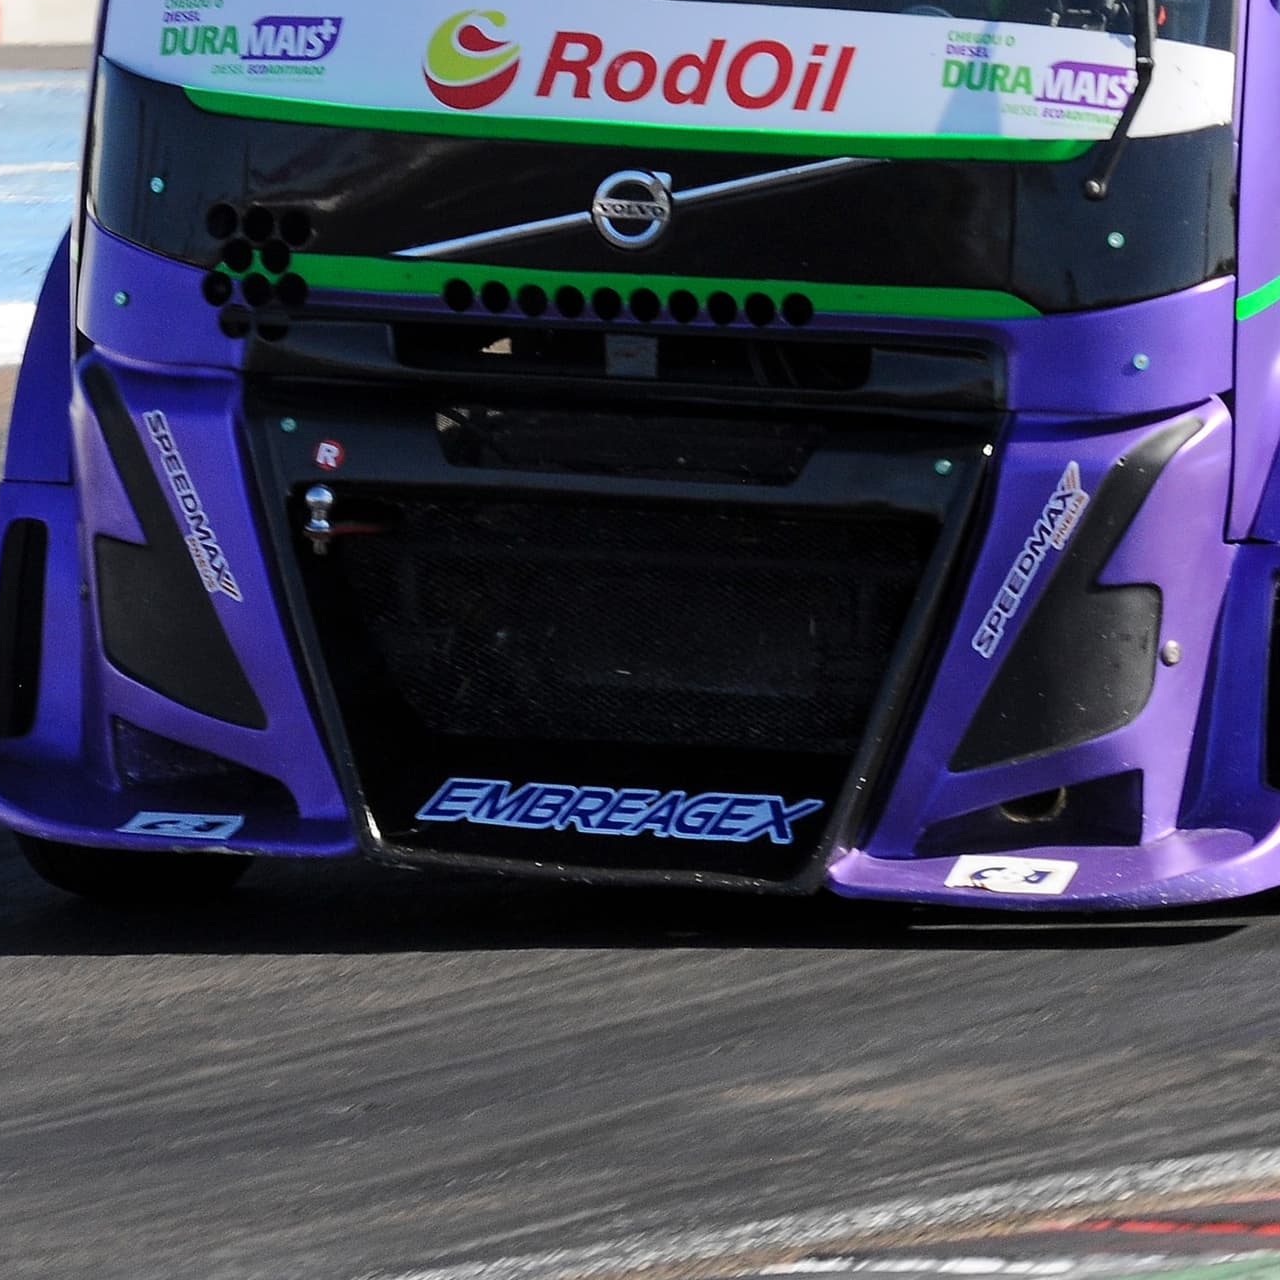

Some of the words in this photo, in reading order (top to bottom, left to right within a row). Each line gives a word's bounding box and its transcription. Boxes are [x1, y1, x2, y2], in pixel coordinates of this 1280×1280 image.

[160, 24, 238, 56] DURA
[535, 31, 855, 114] RodOil
[942, 58, 1033, 96] DURA
[316, 441, 340, 468] R
[144, 411, 230, 584] SPEEDMAX
[974, 490, 1074, 656] SPEEDMAX
[417, 778, 824, 845] EMBREAGEX
